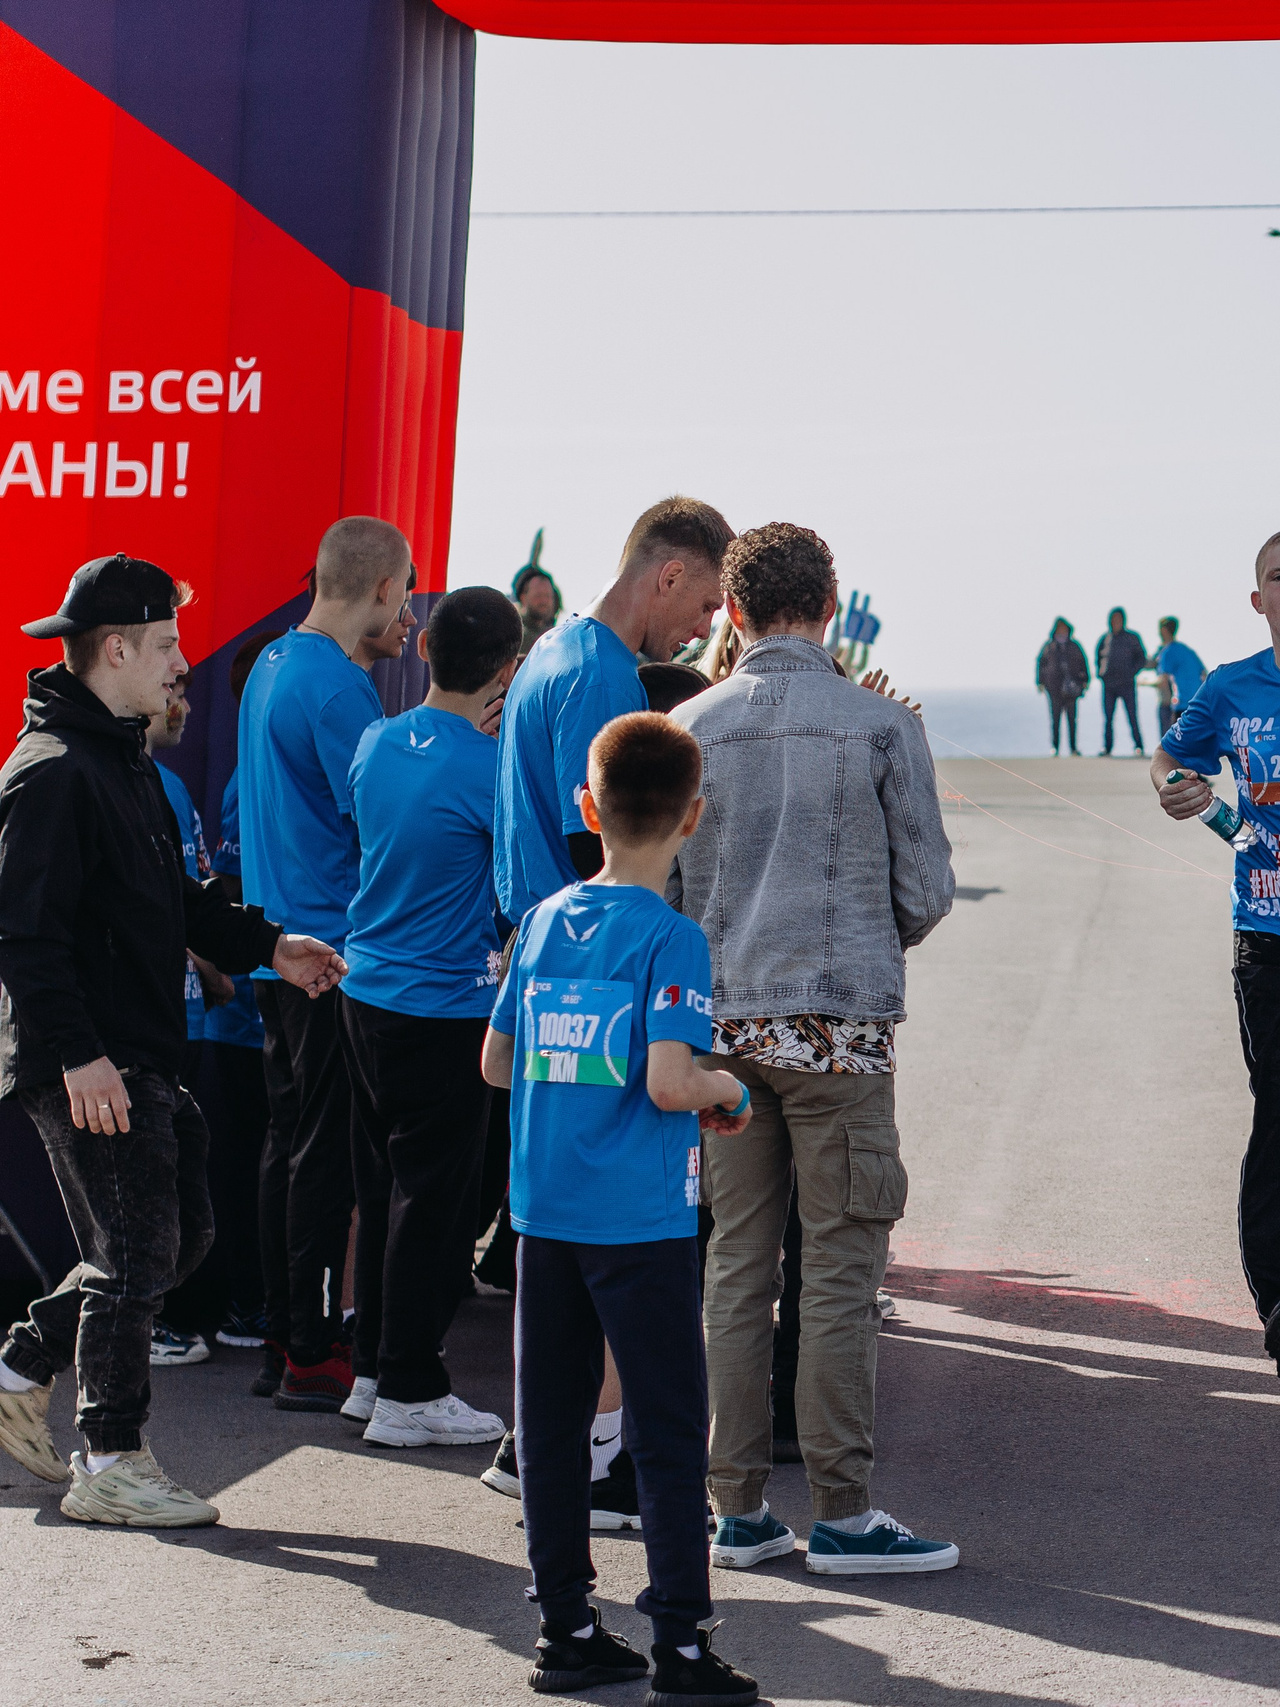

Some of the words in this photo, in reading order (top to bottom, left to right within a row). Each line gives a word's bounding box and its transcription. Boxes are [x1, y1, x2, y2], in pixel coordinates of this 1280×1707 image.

[107, 357, 262, 414] всей
[0, 441, 190, 498] АНЫ!
[538, 1012, 600, 1048] 10037
